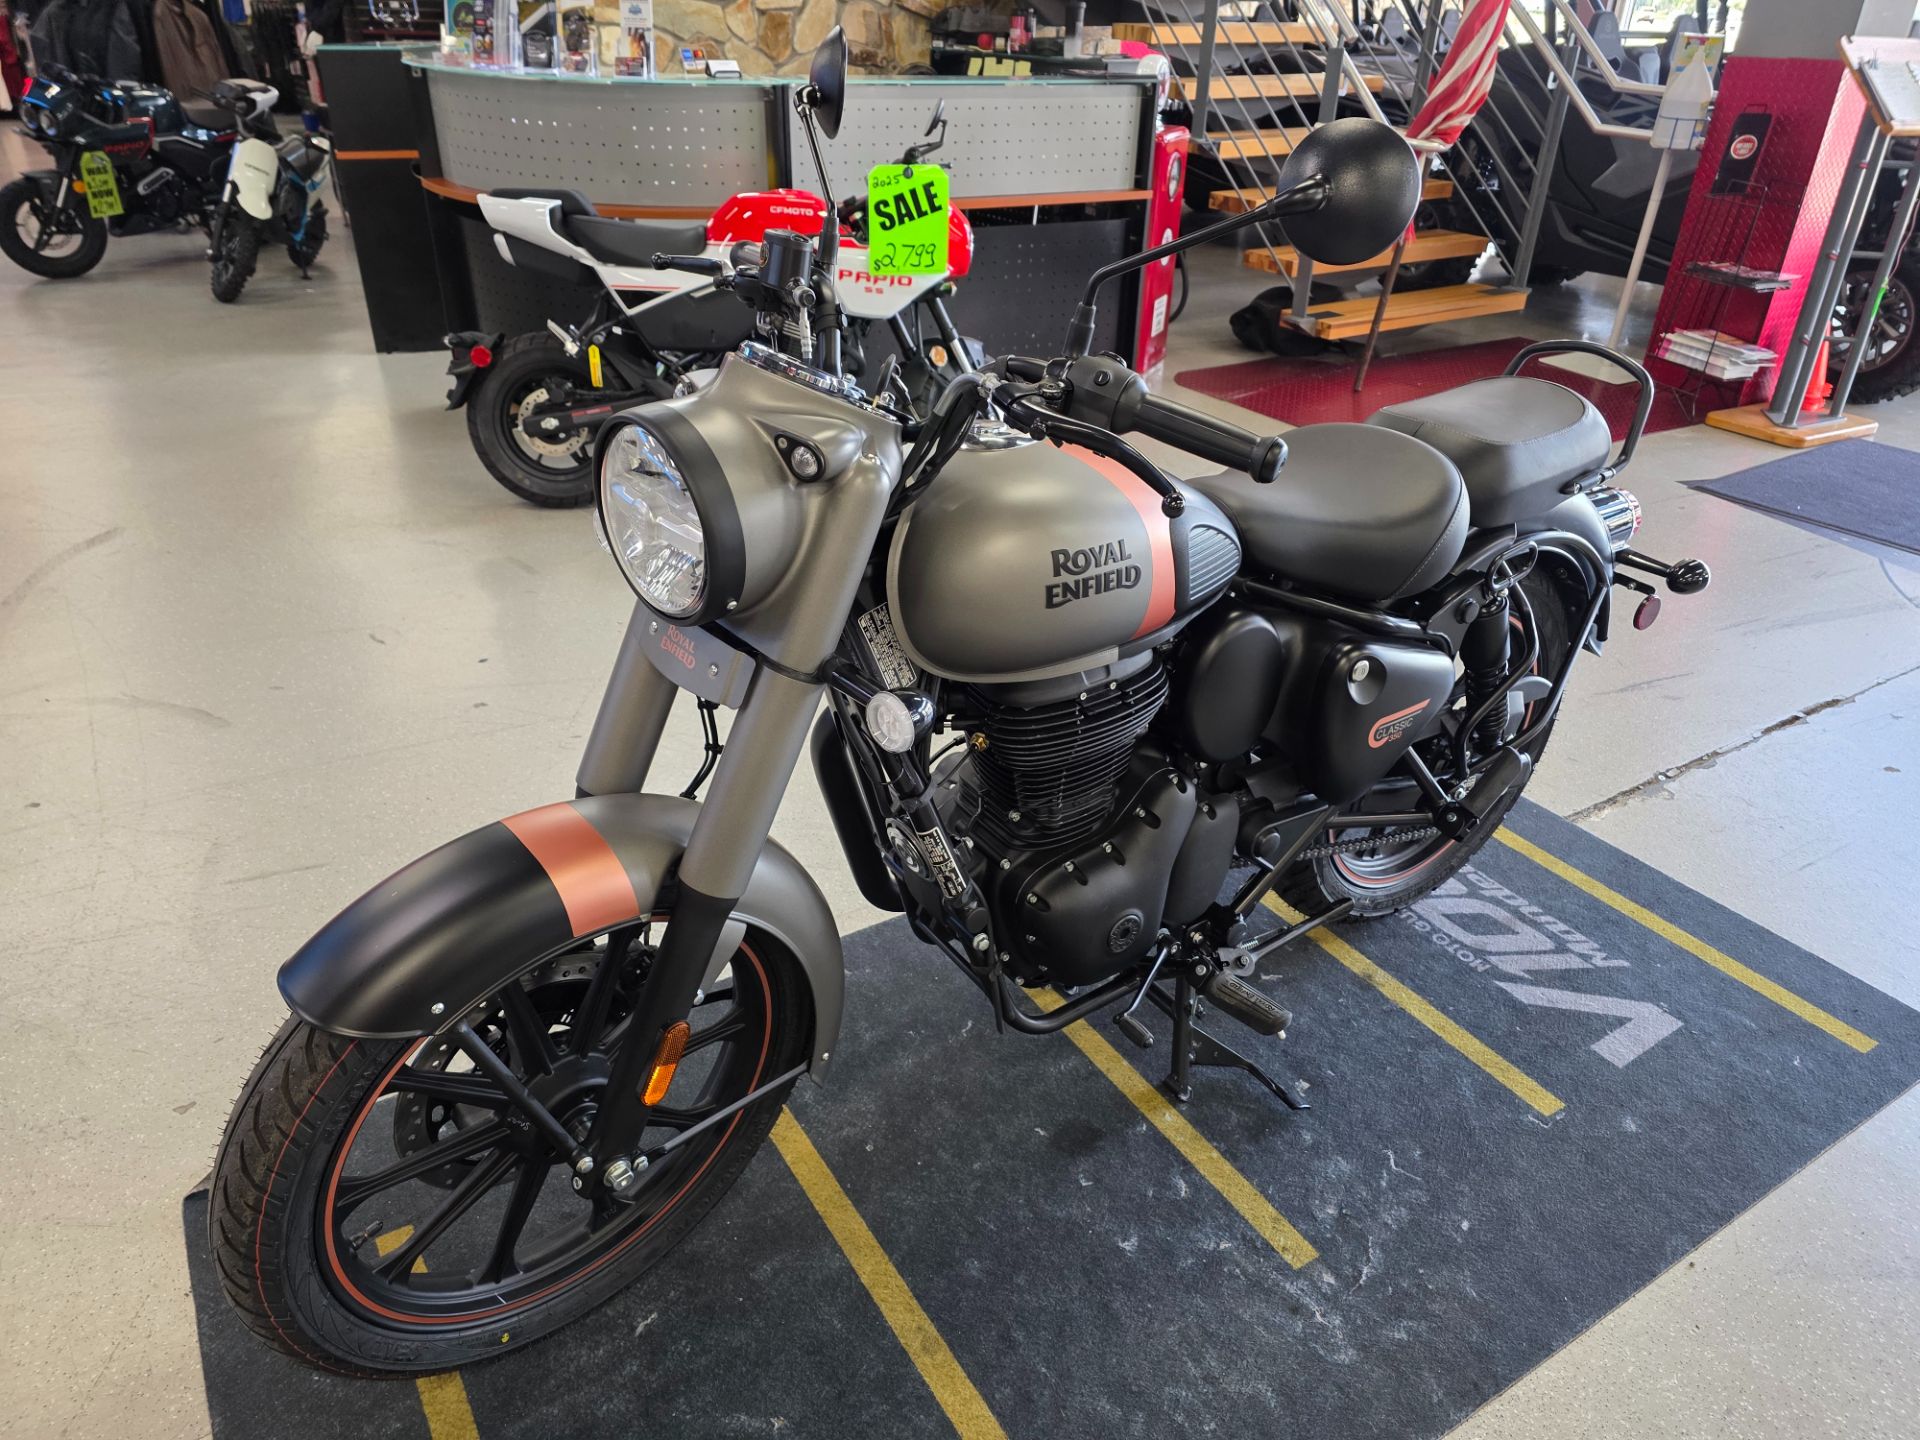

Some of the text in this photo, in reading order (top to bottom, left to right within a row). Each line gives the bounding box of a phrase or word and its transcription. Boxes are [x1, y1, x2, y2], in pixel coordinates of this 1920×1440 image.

[872, 174, 904, 188] 2025
[769, 205, 814, 217] CFMOTO
[874, 180, 942, 231] SALE
[874, 243, 937, 271] $2,799
[838, 269, 913, 287] PAPIO
[1051, 538, 1131, 577] ROYAL
[1045, 564, 1142, 609] ENFIELD
[668, 624, 695, 653] ROYAL
[661, 636, 696, 671] ENFIELD
[1376, 718, 1413, 740] CLASSIC
[1395, 908, 1492, 973] MOTO GU
